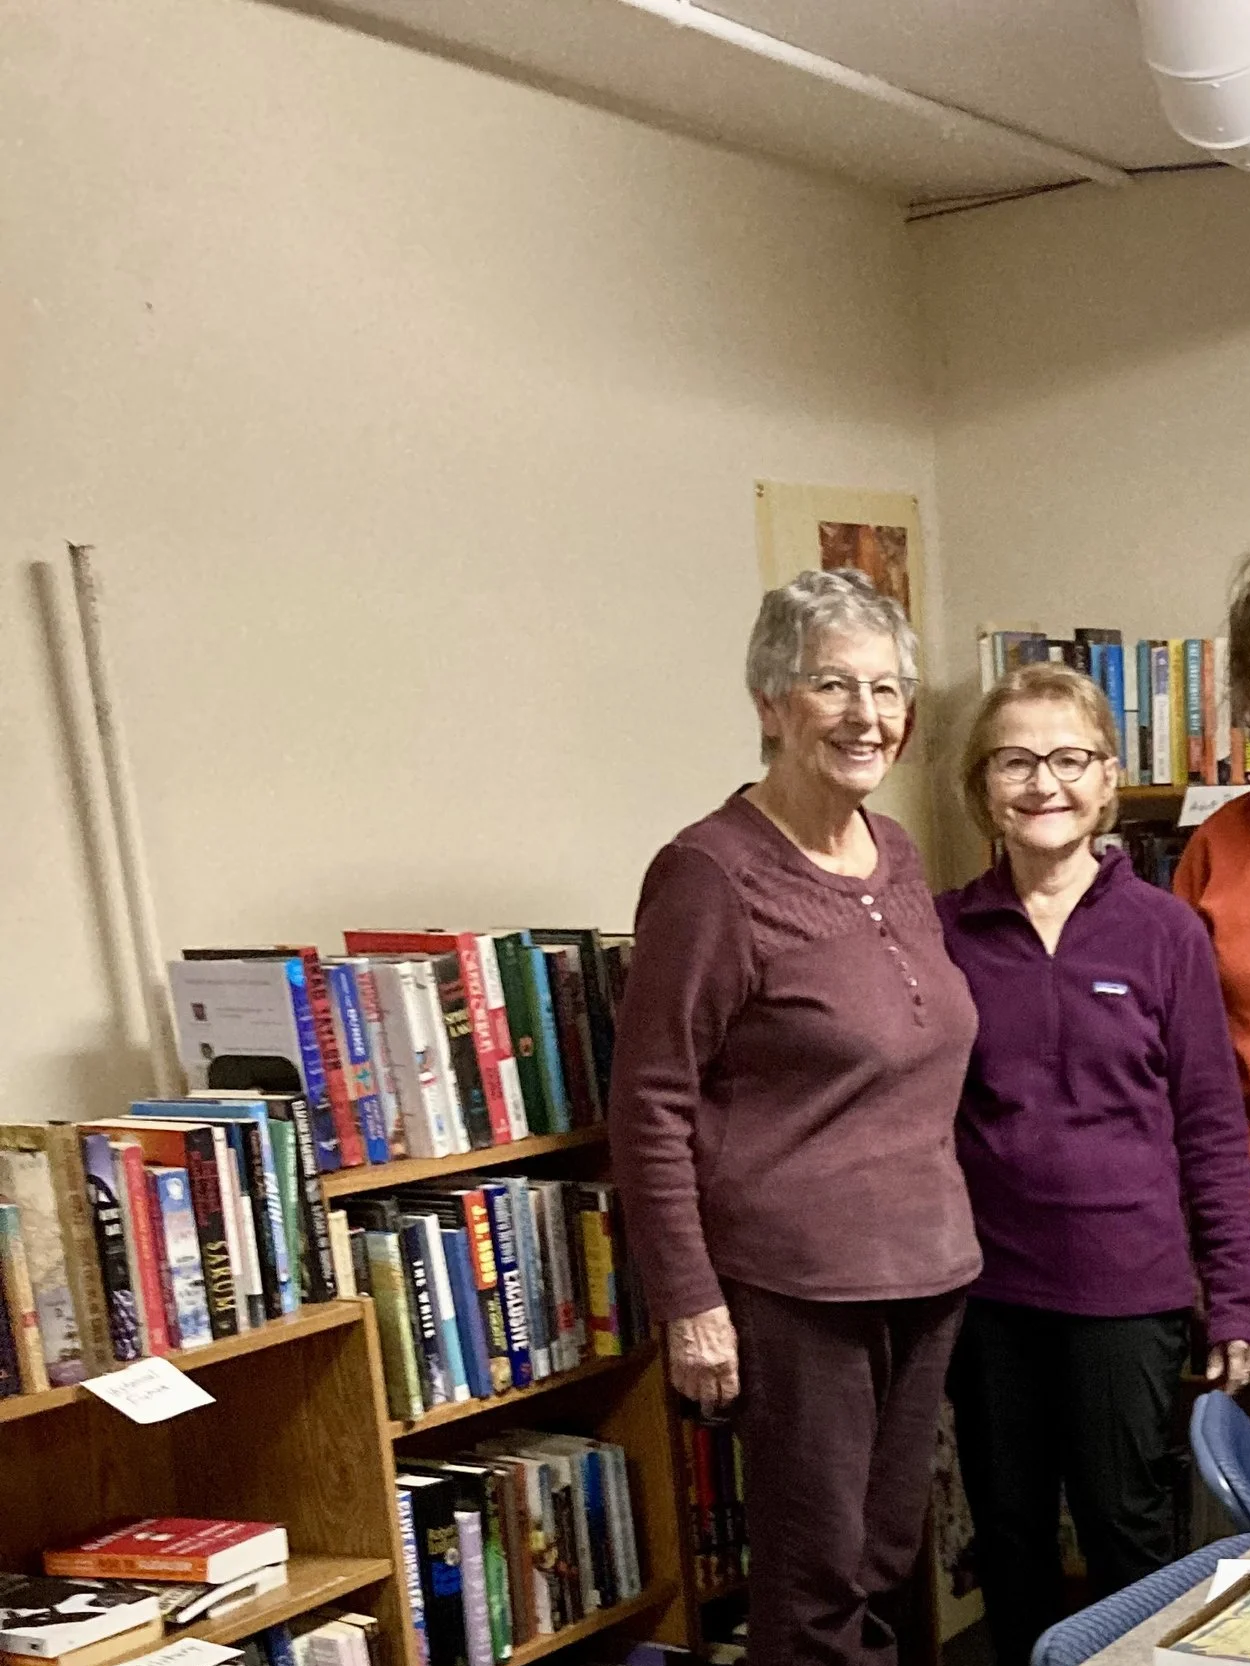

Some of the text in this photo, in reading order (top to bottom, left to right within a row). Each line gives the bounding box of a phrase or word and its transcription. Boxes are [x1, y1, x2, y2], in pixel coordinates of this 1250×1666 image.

[346, 1008, 366, 1056] BURKE
[206, 1241, 236, 1311] SARUM
[412, 1259, 436, 1339] THE WHITE
[504, 1270, 529, 1351] EXCLUSIVE
[396, 1500, 425, 1608] CLIVE CUSSLER
